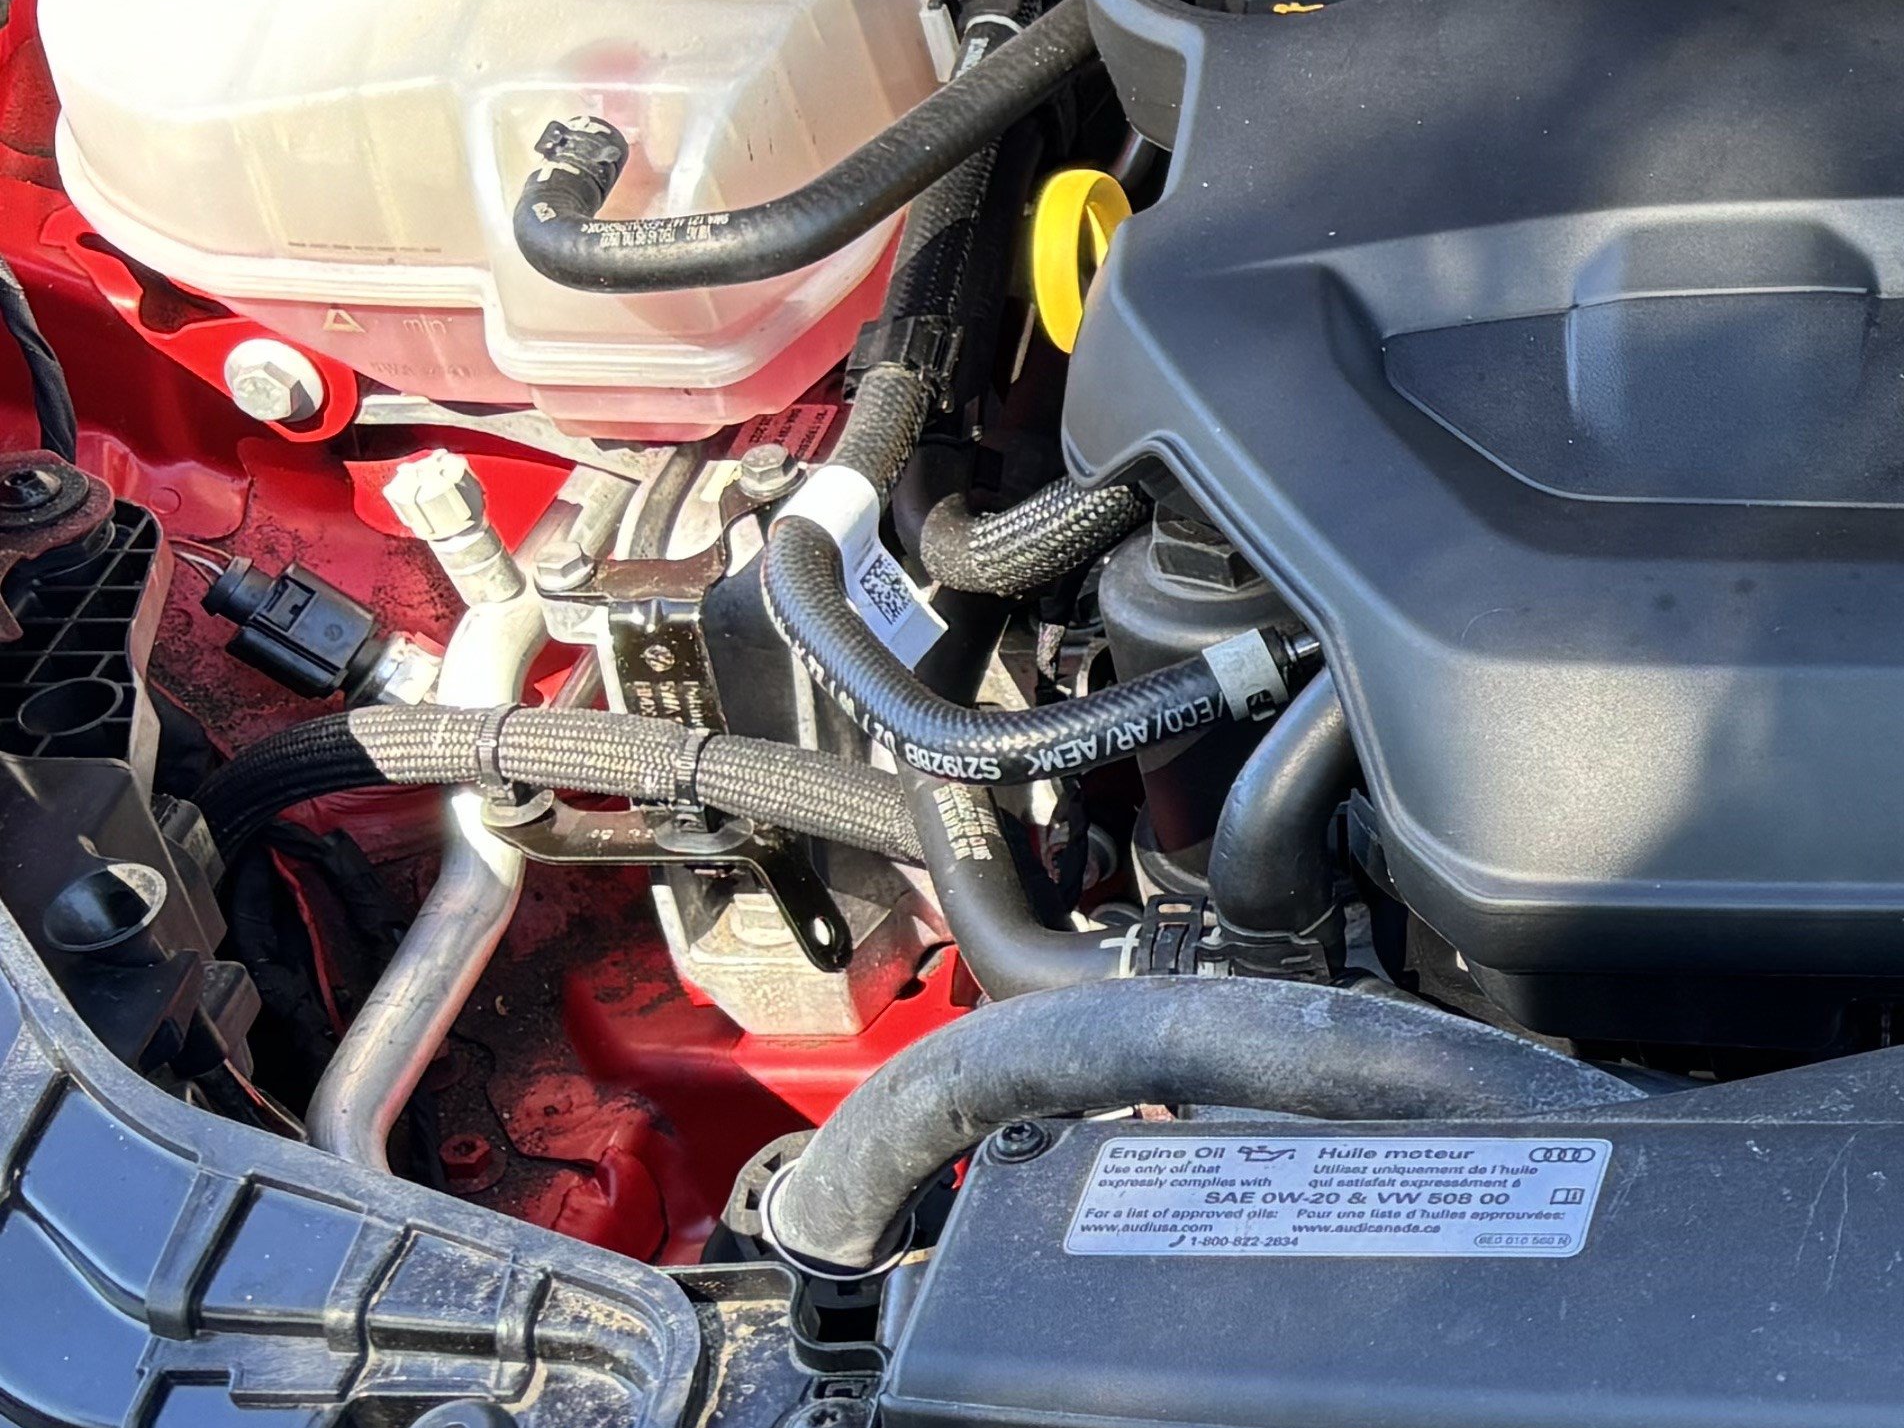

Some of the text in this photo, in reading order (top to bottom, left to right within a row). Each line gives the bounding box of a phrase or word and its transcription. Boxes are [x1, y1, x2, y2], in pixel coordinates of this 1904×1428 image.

[1110, 1147, 1226, 1160] Engine Oil
[1318, 1148, 1474, 1160] Huile moteur
[1103, 1165, 1129, 1173] Use
[1135, 1165, 1165, 1175] only
[1191, 1164, 1221, 1173] that
[1372, 1165, 1465, 1176] uniquement
[1468, 1165, 1487, 1175] de
[1170, 1178, 1236, 1188] complies
[1240, 1178, 1271, 1187] with
[1308, 1178, 1333, 1189] qui
[1205, 1192, 1510, 1205] SAE 0W-20 & VW 508 00
[1085, 1208, 1110, 1219] For
[1113, 1210, 1123, 1219] a
[1126, 1208, 1149, 1219] list
[1152, 1208, 1169, 1219] of
[1172, 1208, 1243, 1220] approved
[1297, 1209, 1333, 1219] Pour
[1337, 1210, 1366, 1219] une
